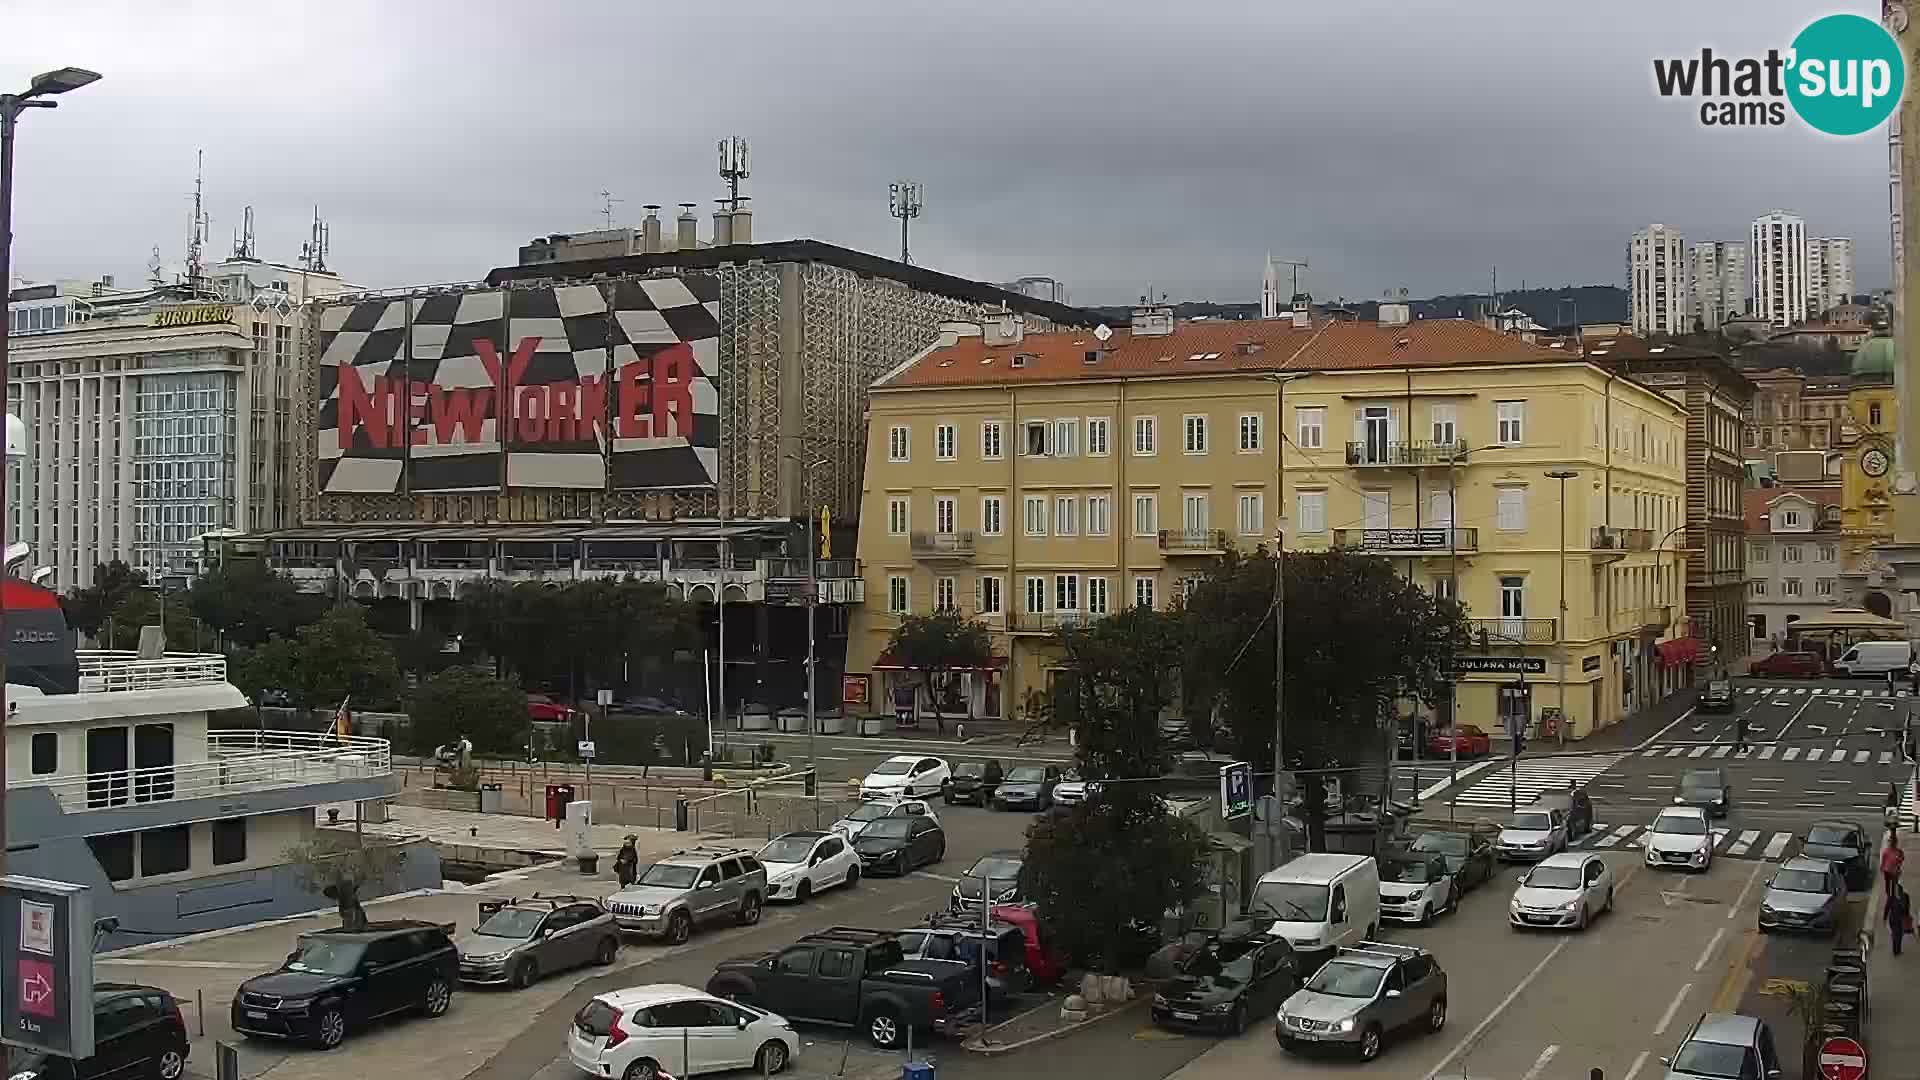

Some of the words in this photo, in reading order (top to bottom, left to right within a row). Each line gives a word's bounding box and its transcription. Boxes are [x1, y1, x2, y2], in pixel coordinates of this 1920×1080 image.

[337, 359, 496, 449] NEW
[473, 336, 694, 443] YORKER
[1508, 661, 1541, 671] NAILS
[27, 1019, 42, 1033] km
